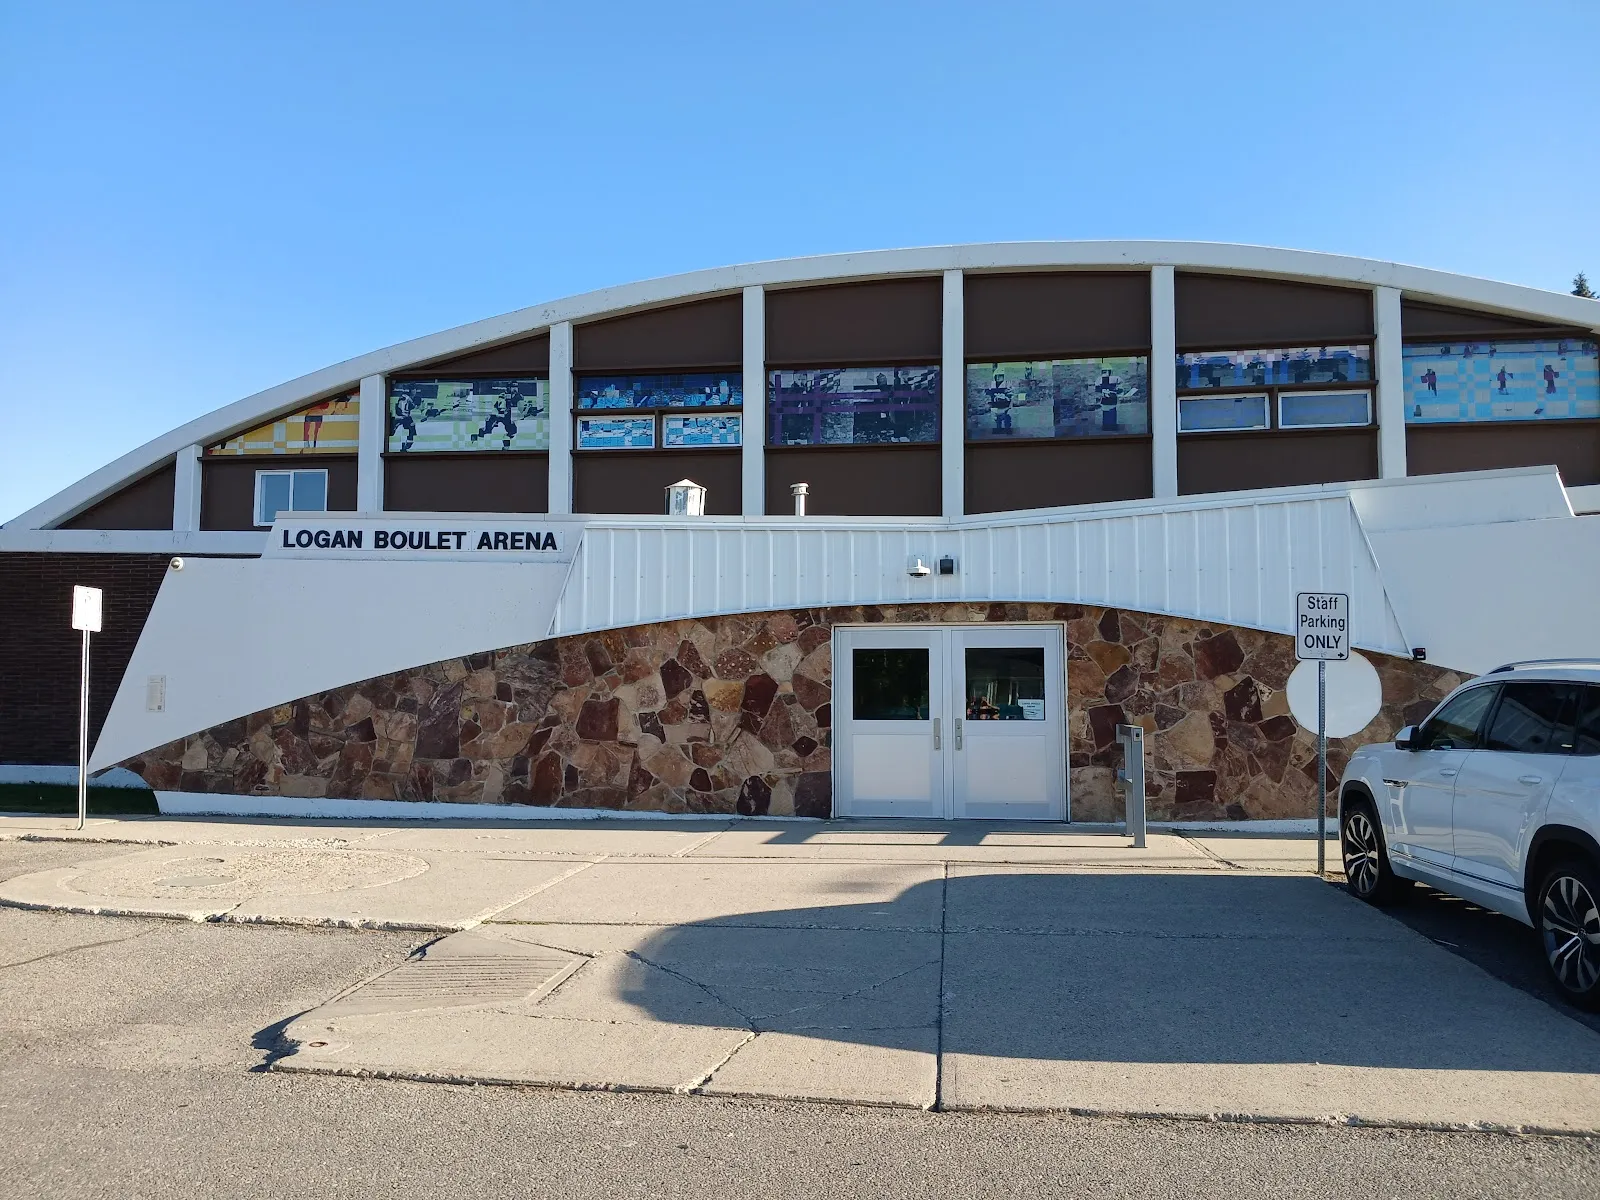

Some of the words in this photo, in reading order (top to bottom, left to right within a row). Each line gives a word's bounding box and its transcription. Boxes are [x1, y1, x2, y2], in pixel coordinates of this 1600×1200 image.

[283, 530, 362, 548] LOGAN
[374, 531, 467, 550] BOULET
[477, 531, 558, 551] ARENA
[1307, 596, 1338, 610] Staff
[1300, 614, 1345, 632] Parking
[1304, 634, 1342, 649] ONLY
